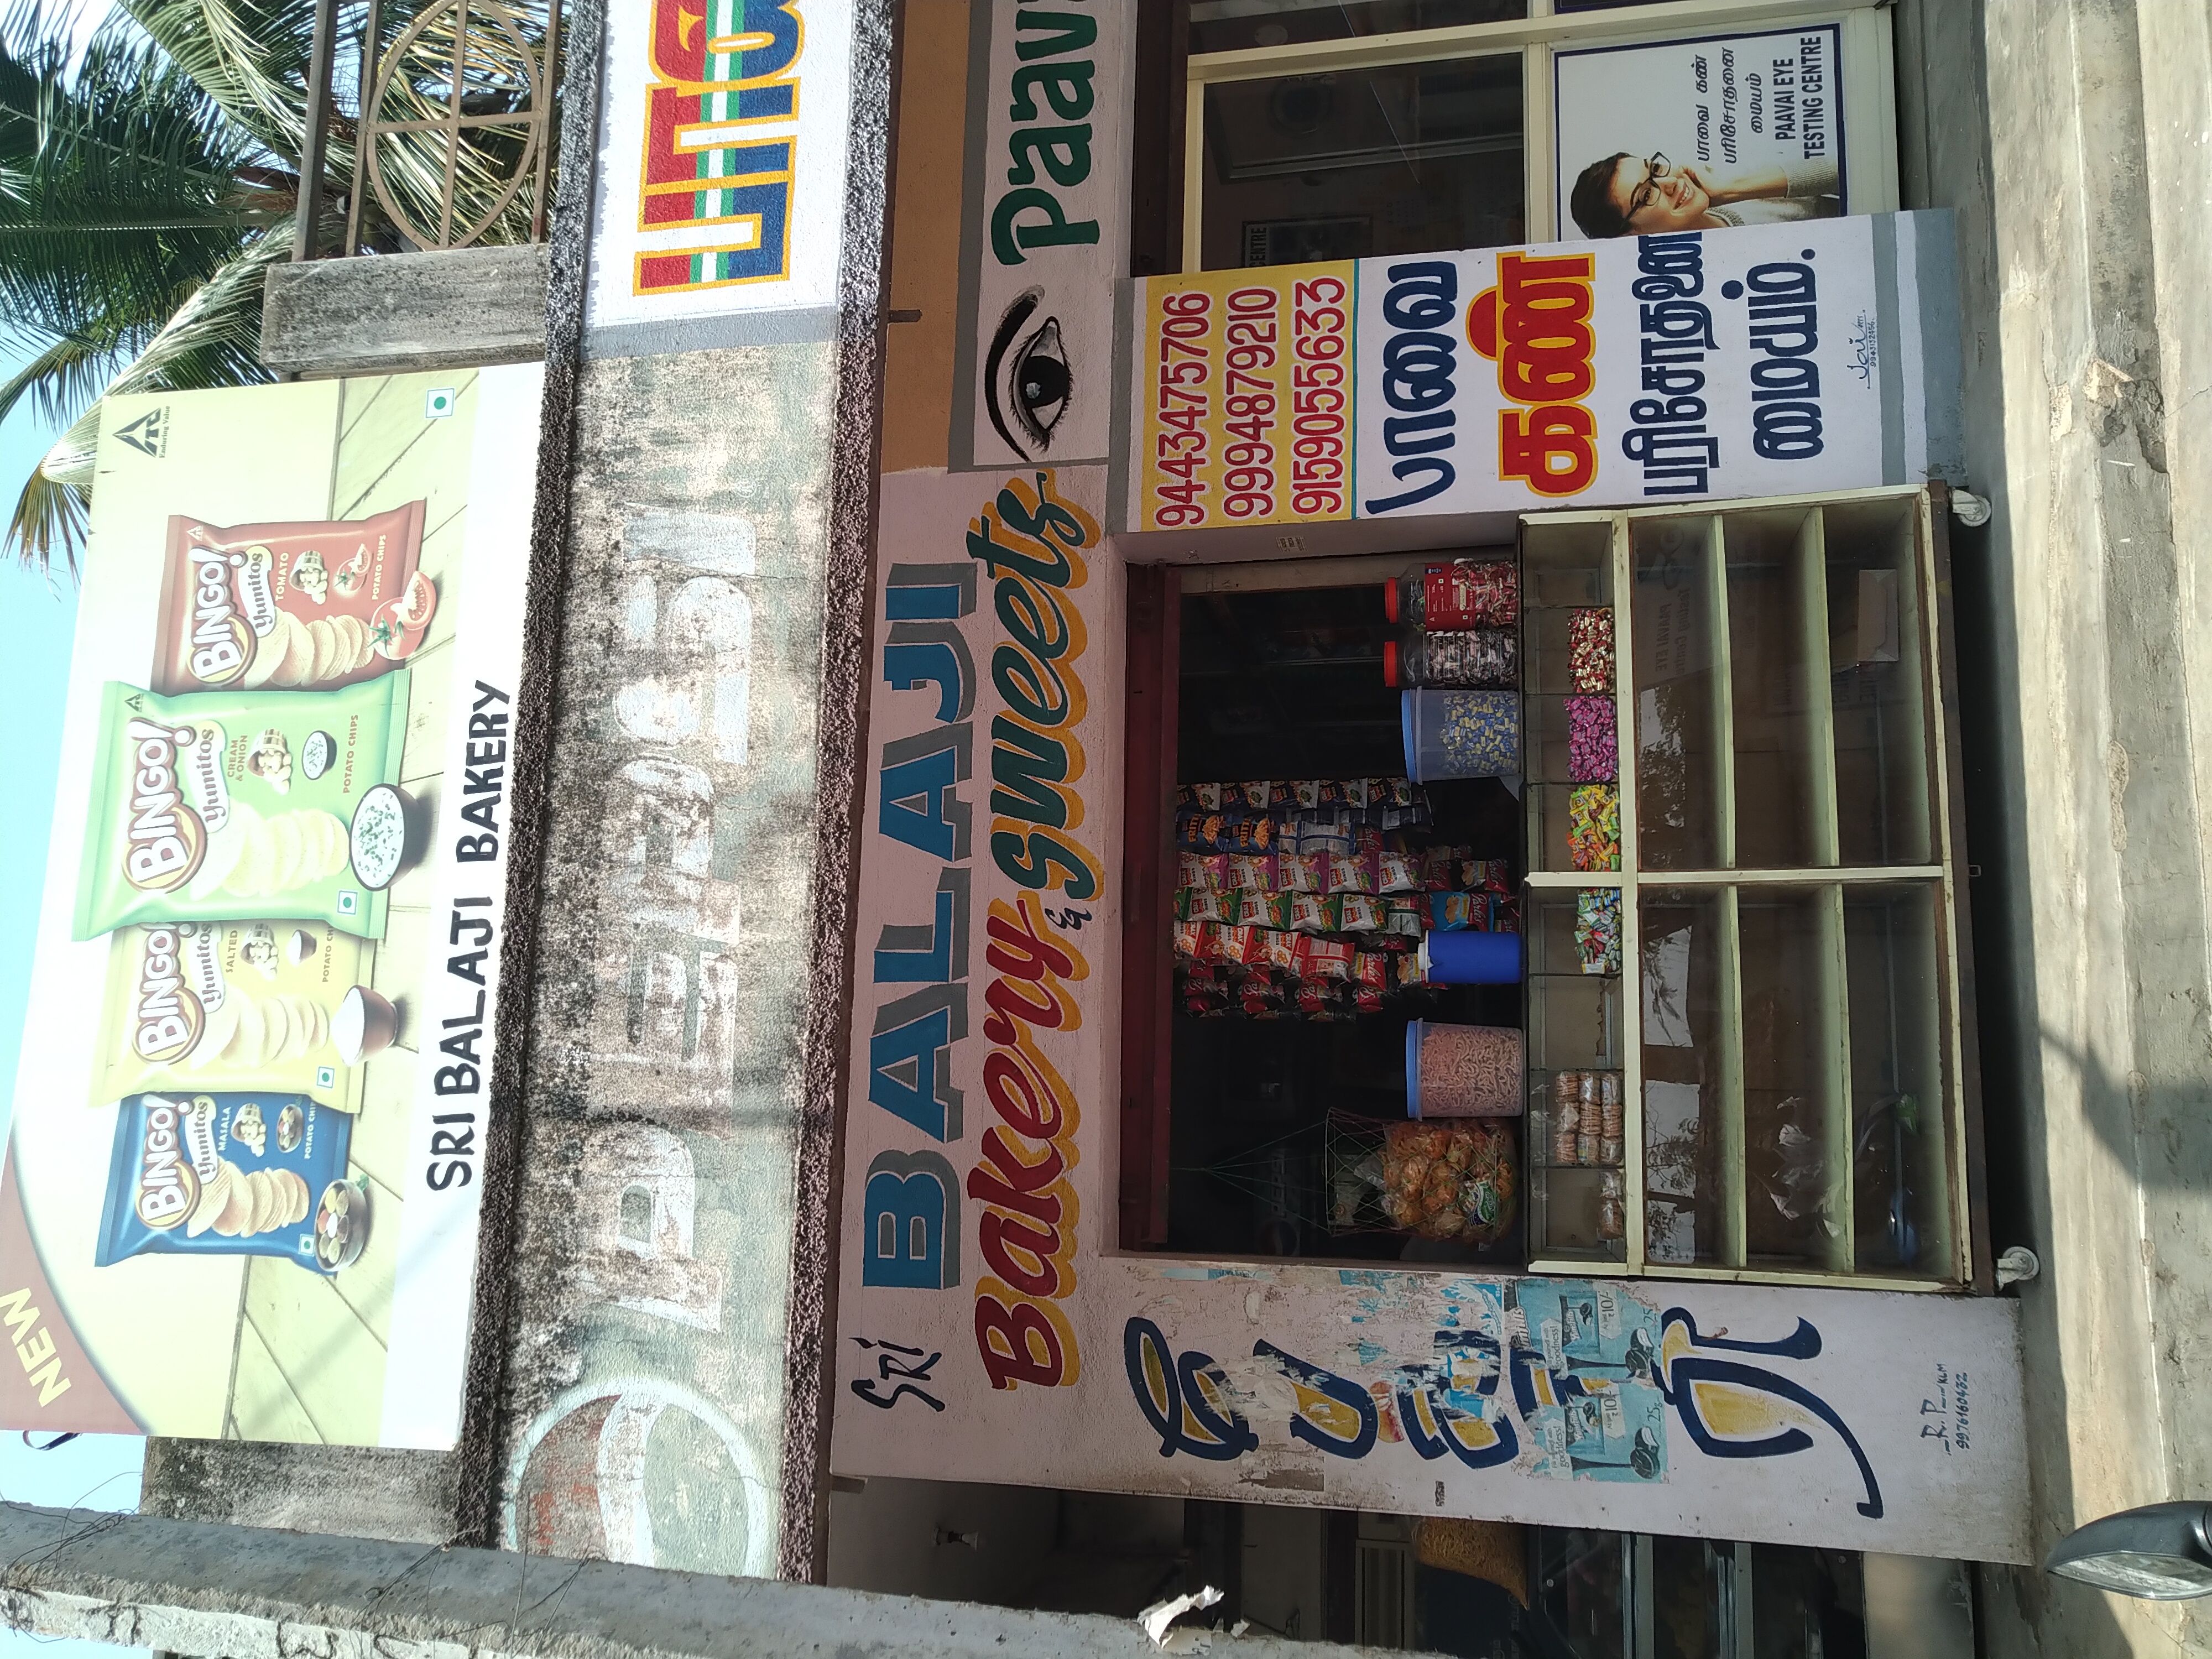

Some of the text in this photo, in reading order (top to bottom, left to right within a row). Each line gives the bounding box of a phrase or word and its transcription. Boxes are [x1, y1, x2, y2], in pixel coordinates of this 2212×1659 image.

[990, 0, 1100, 265] Paav
[1691, 54, 1710, 161] பாவை கண்
[1720, 46, 1739, 164] பரிசோதனை
[1745, 72, 1763, 134] மையம்
[1772, 58, 1796, 140] PAAVAI EYE
[1799, 36, 1825, 160] TESTING CENTRE
[1155, 293, 1211, 526] 9443475706
[1223, 289, 1277, 519] 9994879210
[1292, 278, 1346, 514] 9159055633
[1366, 262, 1458, 515] பாவை
[1466, 253, 1598, 496] கண்
[159, 426, 169, 458] Enduring
[188, 548, 242, 677] BINGO!
[247, 553, 273, 629] Yumitos
[275, 552, 289, 601] TOMATO
[372, 535, 387, 600] POTATO CHIPS
[127, 720, 190, 881] BINGO!
[196, 729, 226, 822] Yumitos
[227, 740, 238, 778] CREAM
[237, 735, 248, 773] ONION
[342, 714, 358, 794] POTATO CHIPS
[196, 924, 222, 1004] Yumitos
[225, 930, 238, 973] SALTED
[322, 945, 332, 983] POTATO
[425, 680, 511, 1191] SRI BALAJI BAKERY
[862, 564, 974, 1290] BALAJI
[138, 923, 192, 1055] BINGO!
[140, 1094, 190, 1220] BINGO!
[194, 1102, 215, 1175] Yumitos
[218, 1107, 231, 1151] MASALA
[305, 1125, 314, 1159] POTATO
[967, 893, 1087, 1391] Bakery
[1044, 909, 1092, 930] &
[0, 1287, 71, 1407] NEW
